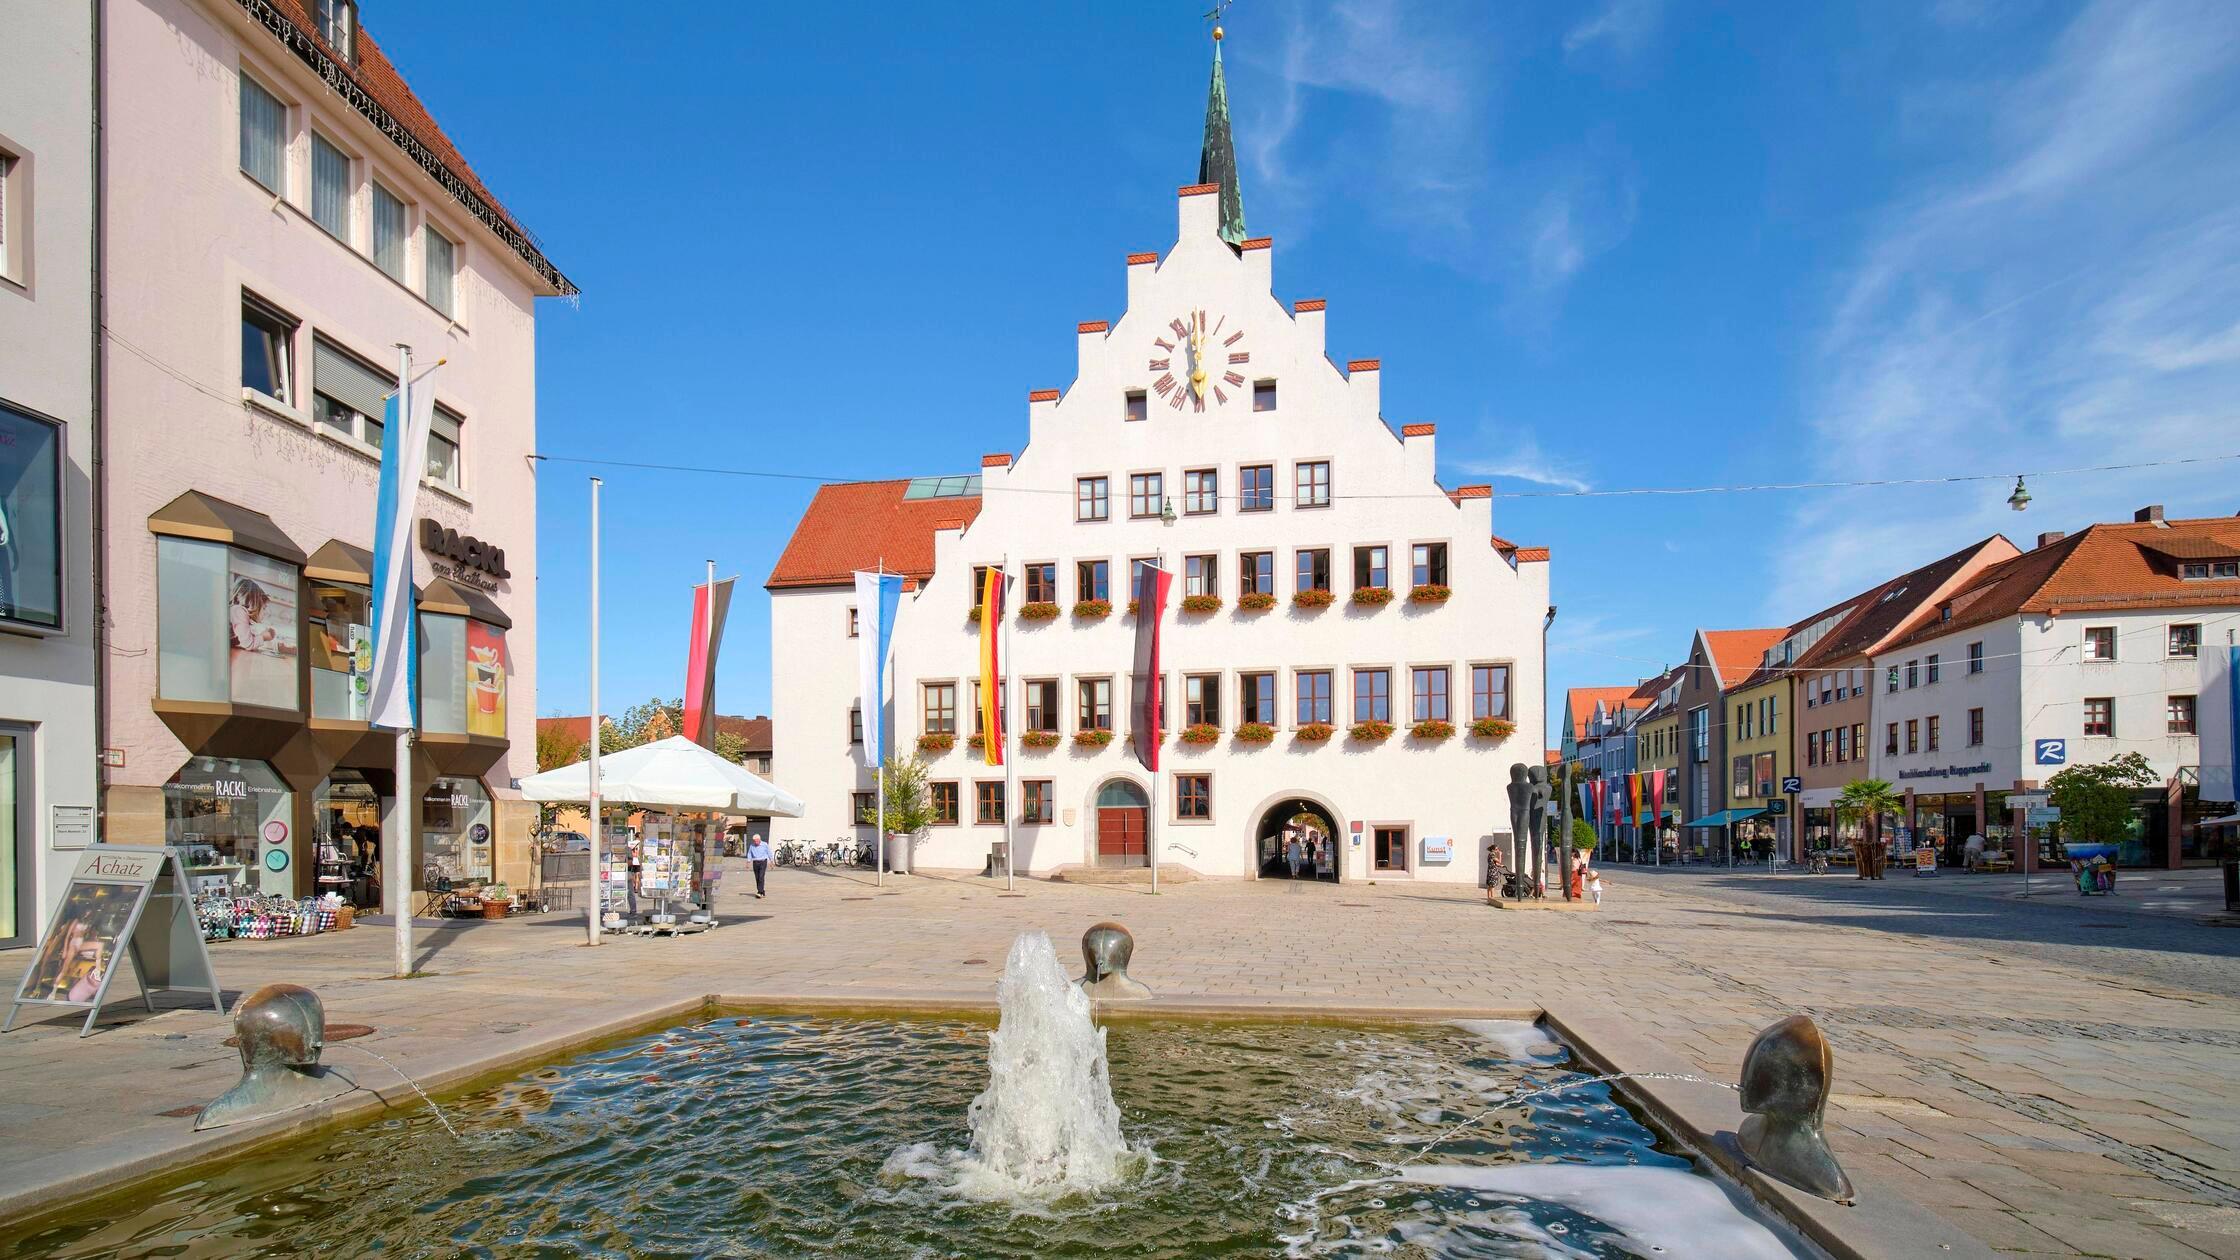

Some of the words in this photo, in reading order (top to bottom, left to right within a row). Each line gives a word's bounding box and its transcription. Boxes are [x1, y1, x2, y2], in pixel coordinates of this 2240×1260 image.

[420, 518, 511, 579] RACKL
[432, 562, 451, 576] am
[452, 562, 498, 592] Rathaus
[215, 780, 247, 796] RACKL
[84, 855, 144, 875] Achatz
